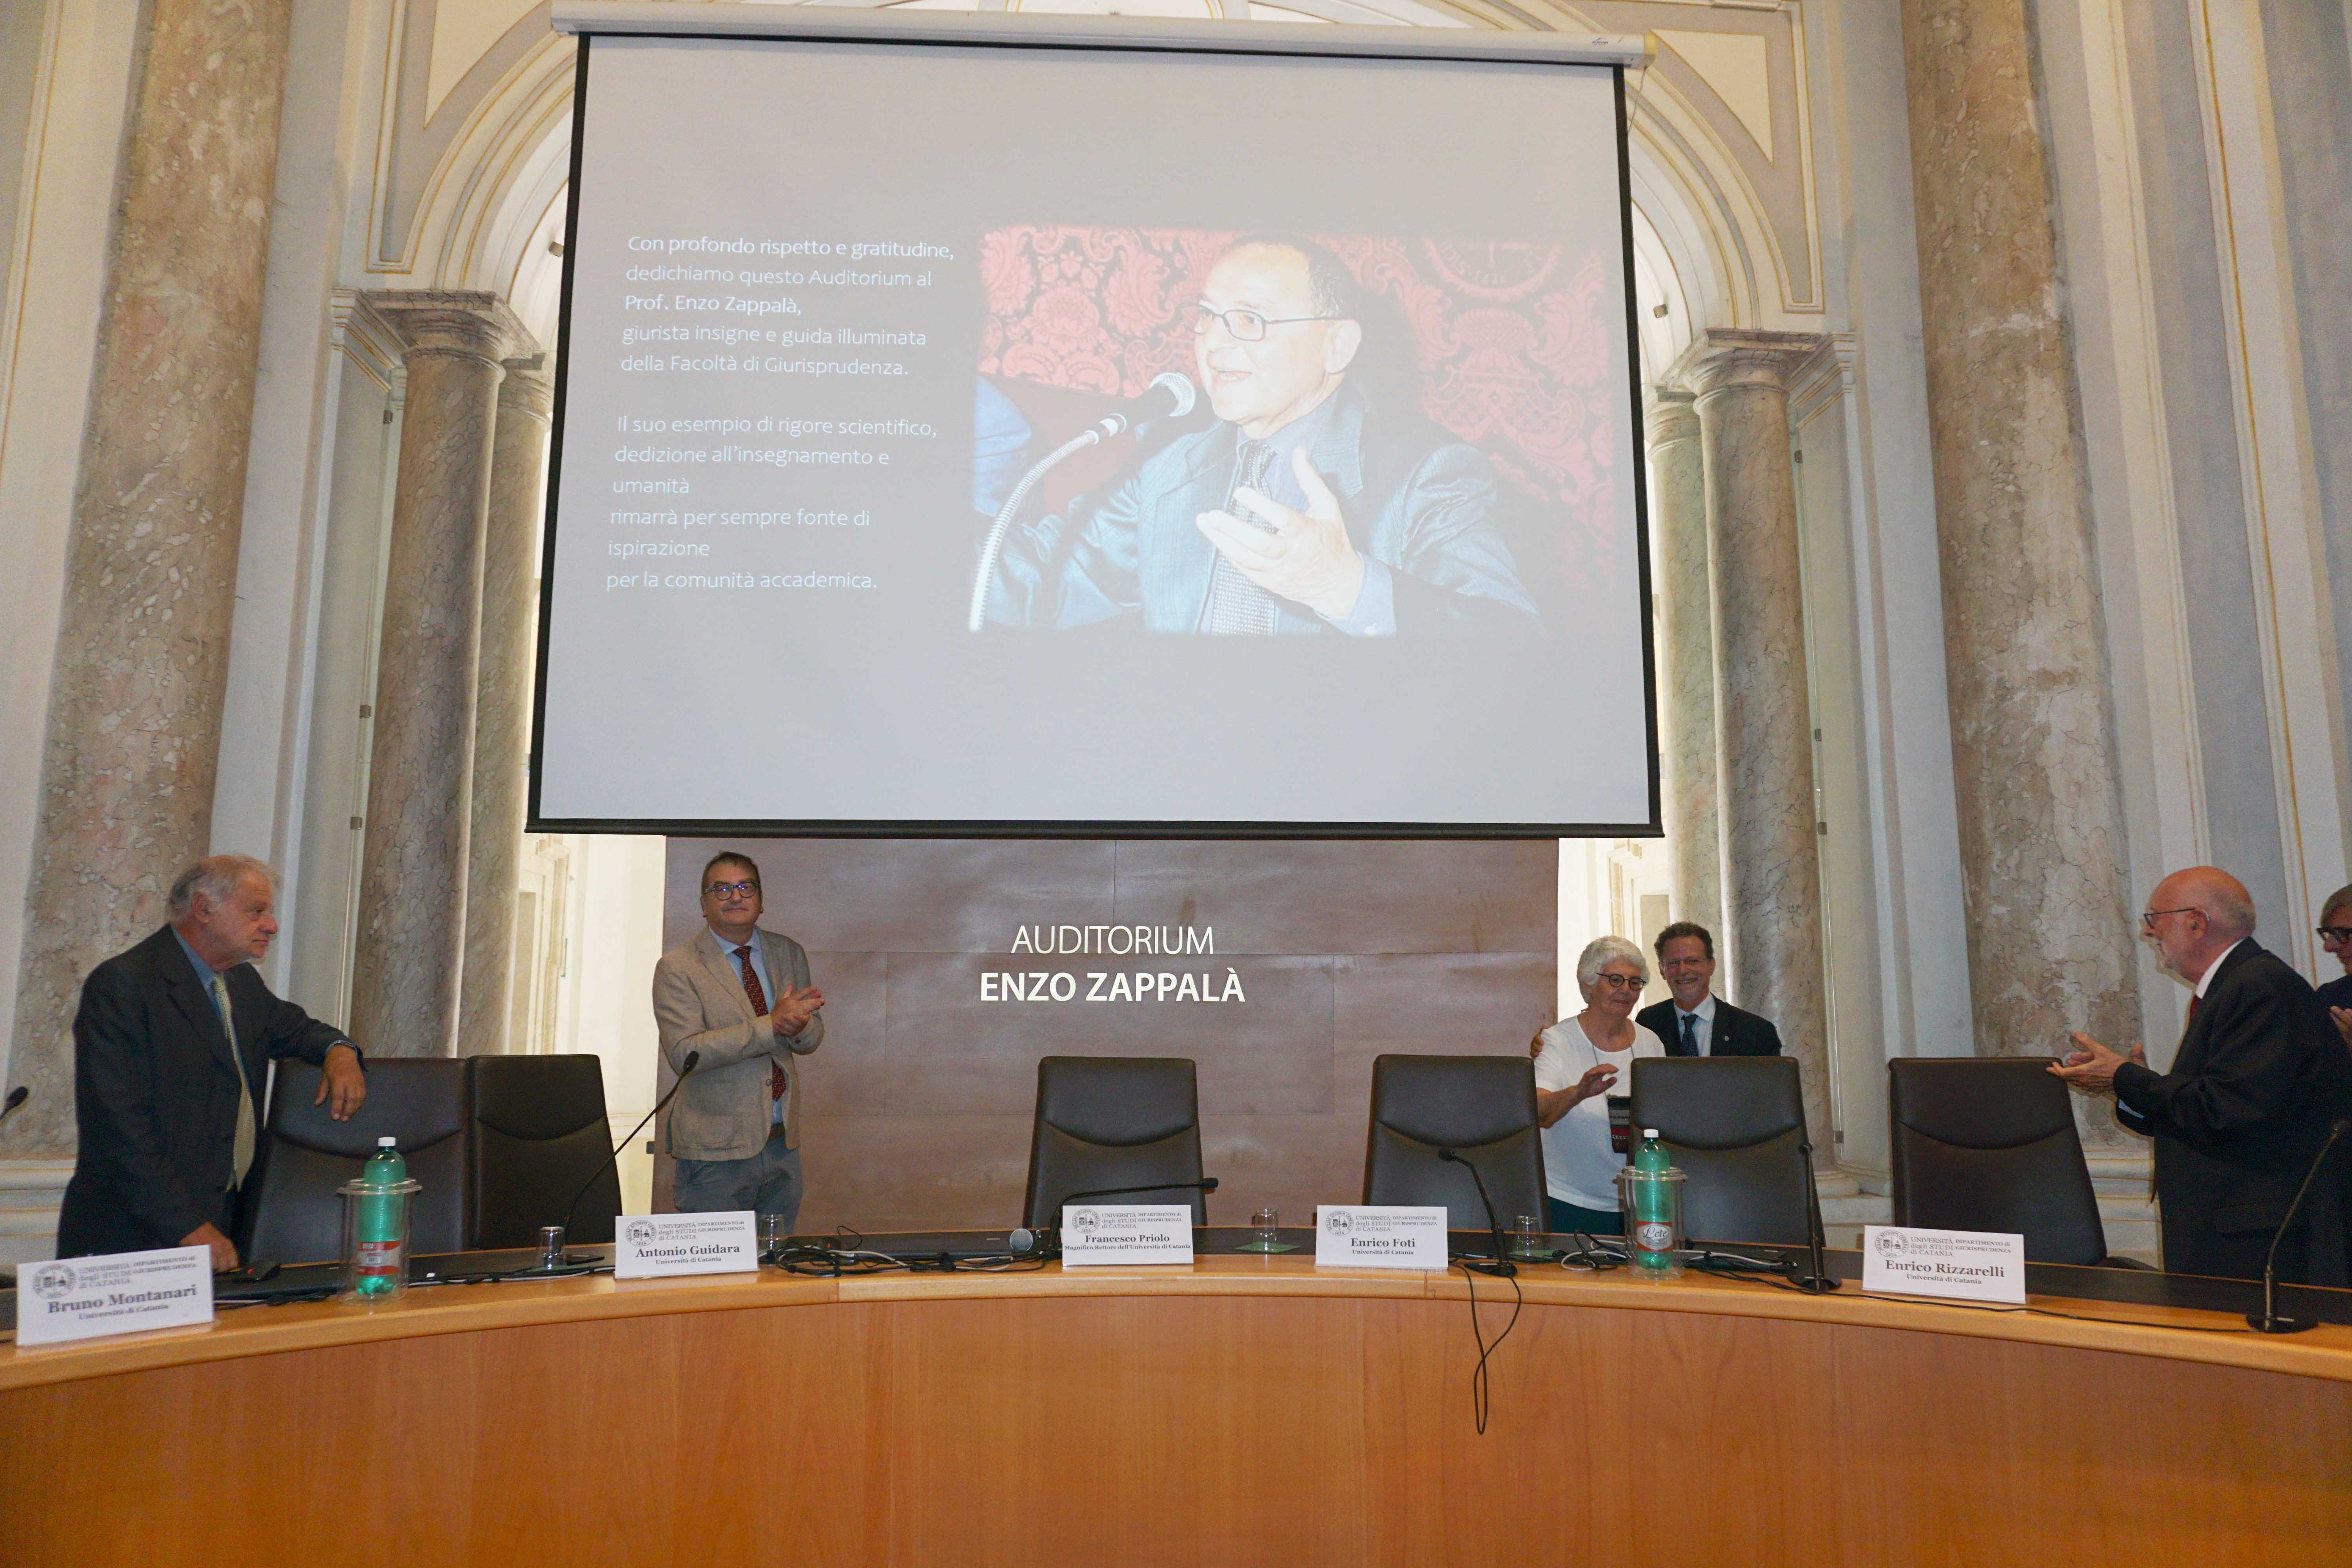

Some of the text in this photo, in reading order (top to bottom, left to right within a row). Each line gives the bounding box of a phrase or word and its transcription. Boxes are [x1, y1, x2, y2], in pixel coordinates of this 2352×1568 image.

[628, 236, 954, 260] Con profondo rispetto e gratitudine,
[626, 265, 931, 287] dedichiamo questo Auditorium al
[625, 294, 801, 316] Prof. Enzo Zappalà,
[622, 325, 926, 347] giurista insigne e guida illuminata
[621, 354, 908, 377] della Facoltà di Giurisprudenza.
[618, 416, 936, 438] Il suo esempio di rigore scientifico,
[615, 446, 706, 462] dedizione
[878, 453, 889, 465] e
[613, 478, 689, 493] umanità
[610, 508, 869, 529] rimarrà per sempre fonte di
[608, 540, 710, 560] ispirazione
[607, 571, 877, 592] per la comunità accademica.
[1011, 925, 1214, 954] AUDITORIUM
[981, 967, 1245, 1002] ENZO ZAPPALÀ
[1351, 1238, 1416, 1247] Enrico Foti
[1643, 1227, 1666, 1238] Lete
[635, 1244, 740, 1258] Antonio Guidara
[1886, 1260, 2004, 1277] Enrico Rizzarelli
[1907, 1274, 1944, 1282] Università
[47, 1284, 198, 1313] Bruno Montanari
